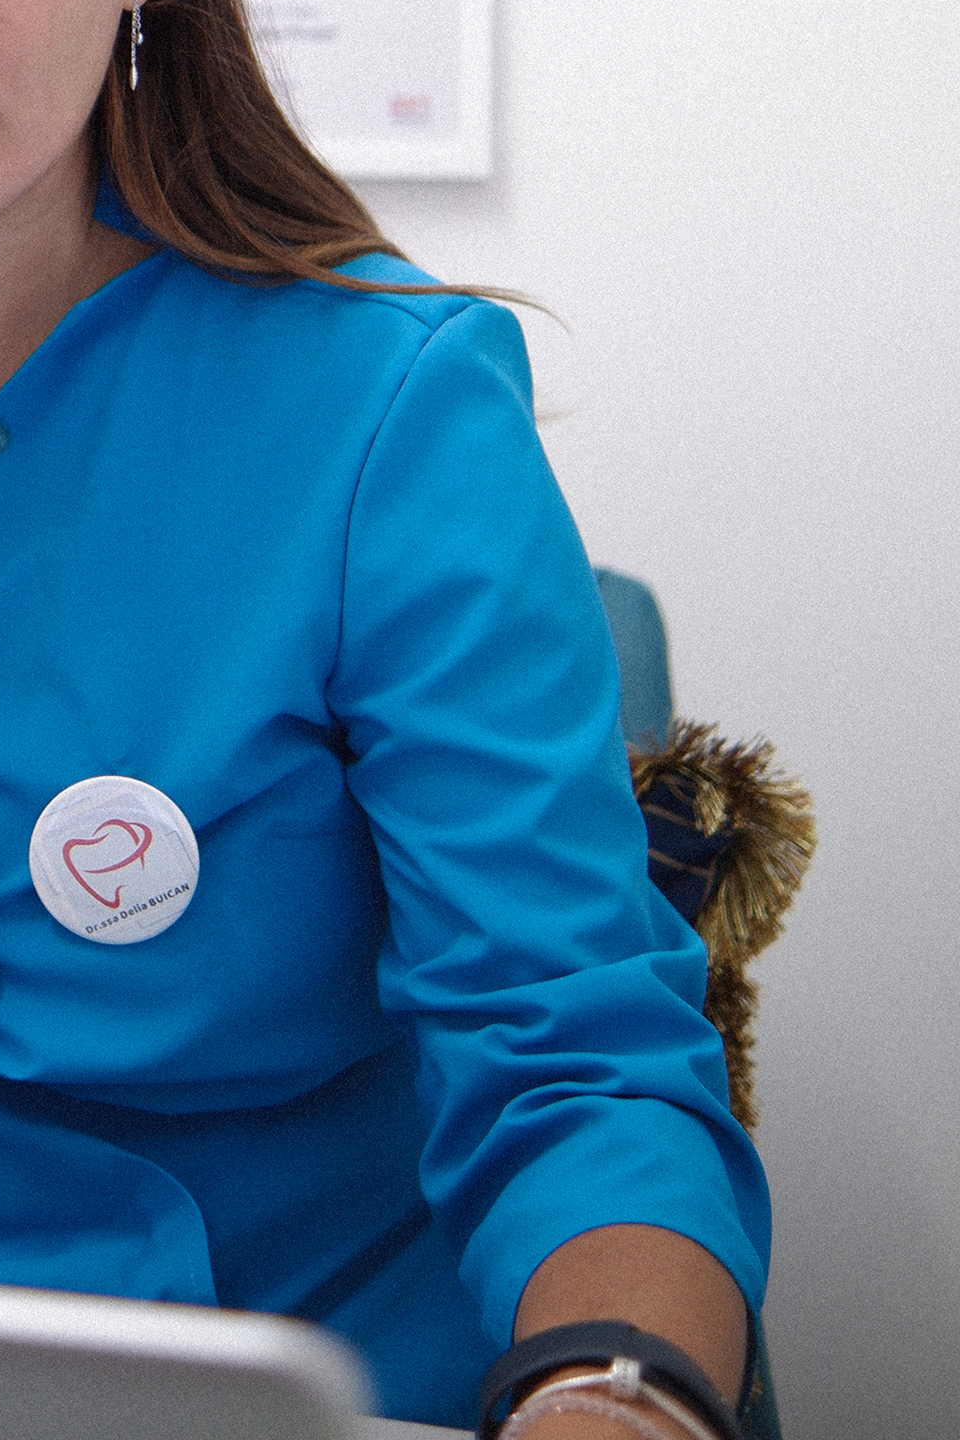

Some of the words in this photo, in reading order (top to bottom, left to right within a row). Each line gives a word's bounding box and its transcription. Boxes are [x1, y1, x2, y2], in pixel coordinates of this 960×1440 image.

[85, 914, 119, 934] Dr.ssa
[119, 902, 148, 920] Delia
[148, 883, 190, 907] BUICAN
